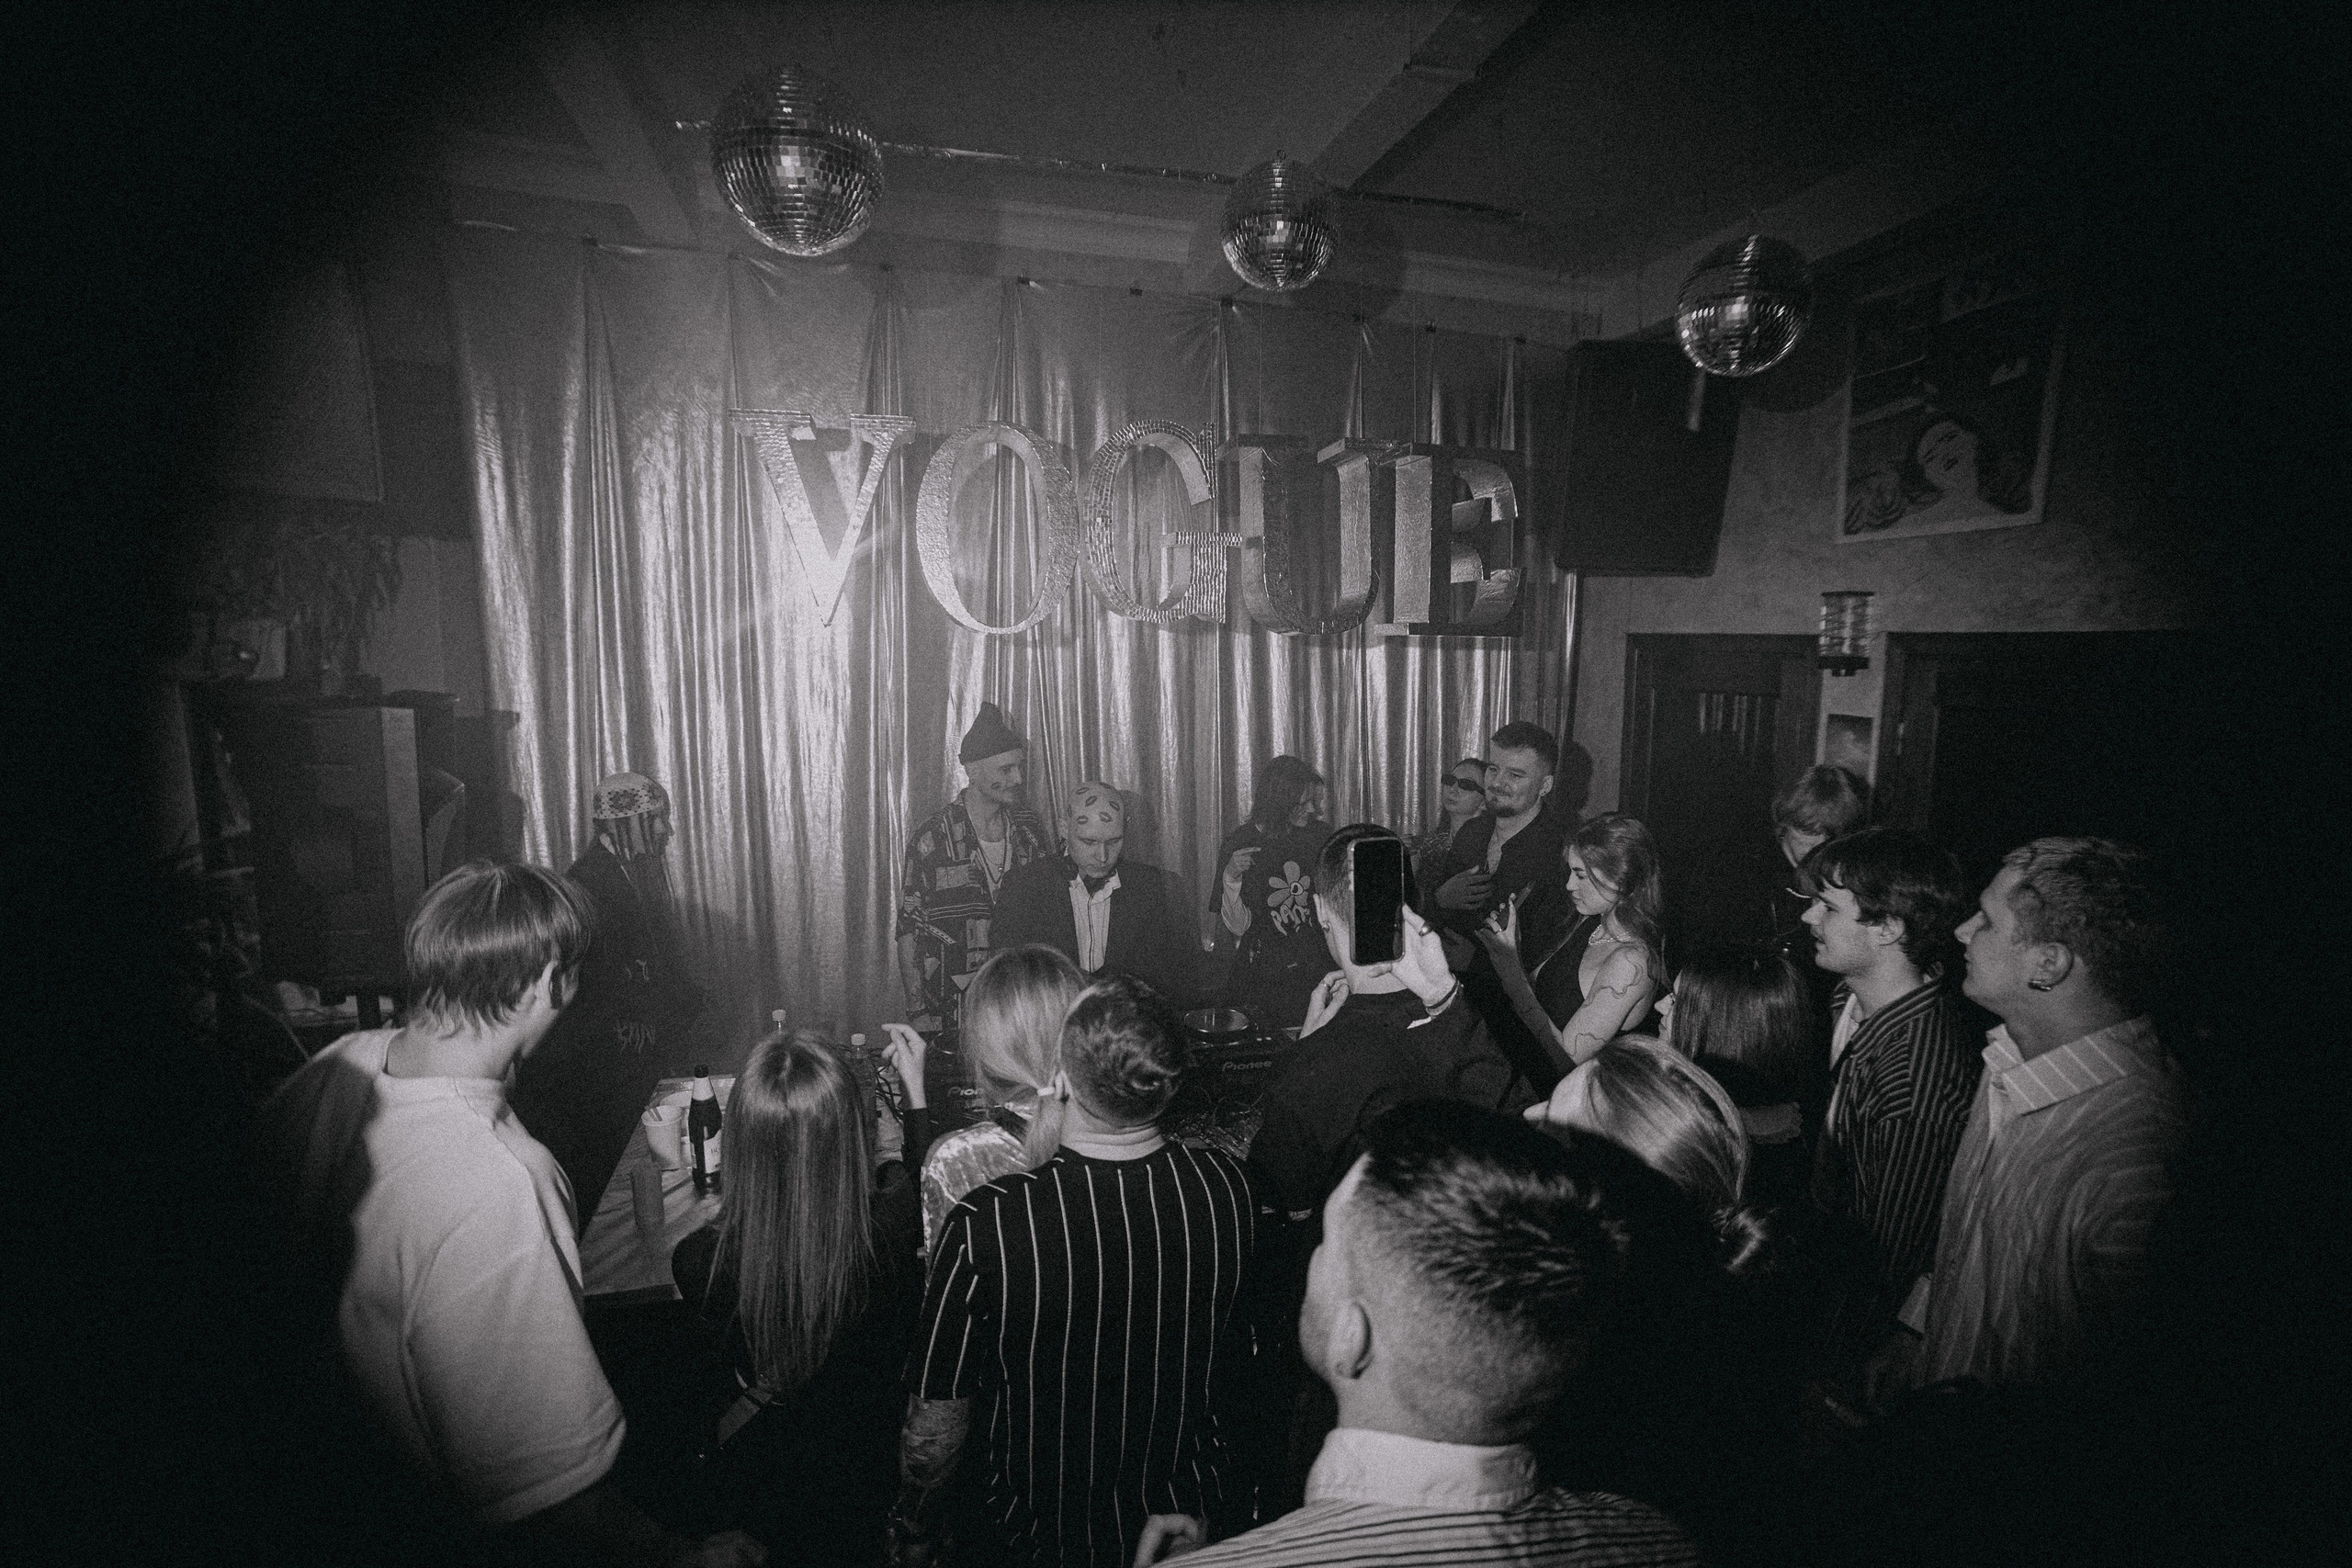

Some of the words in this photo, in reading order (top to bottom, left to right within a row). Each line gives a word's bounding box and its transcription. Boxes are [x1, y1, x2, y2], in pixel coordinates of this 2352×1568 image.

[729, 408, 1522, 636] VOGUE
[1222, 1060, 1272, 1072] Pionee
[947, 1086, 985, 1097] Pion
